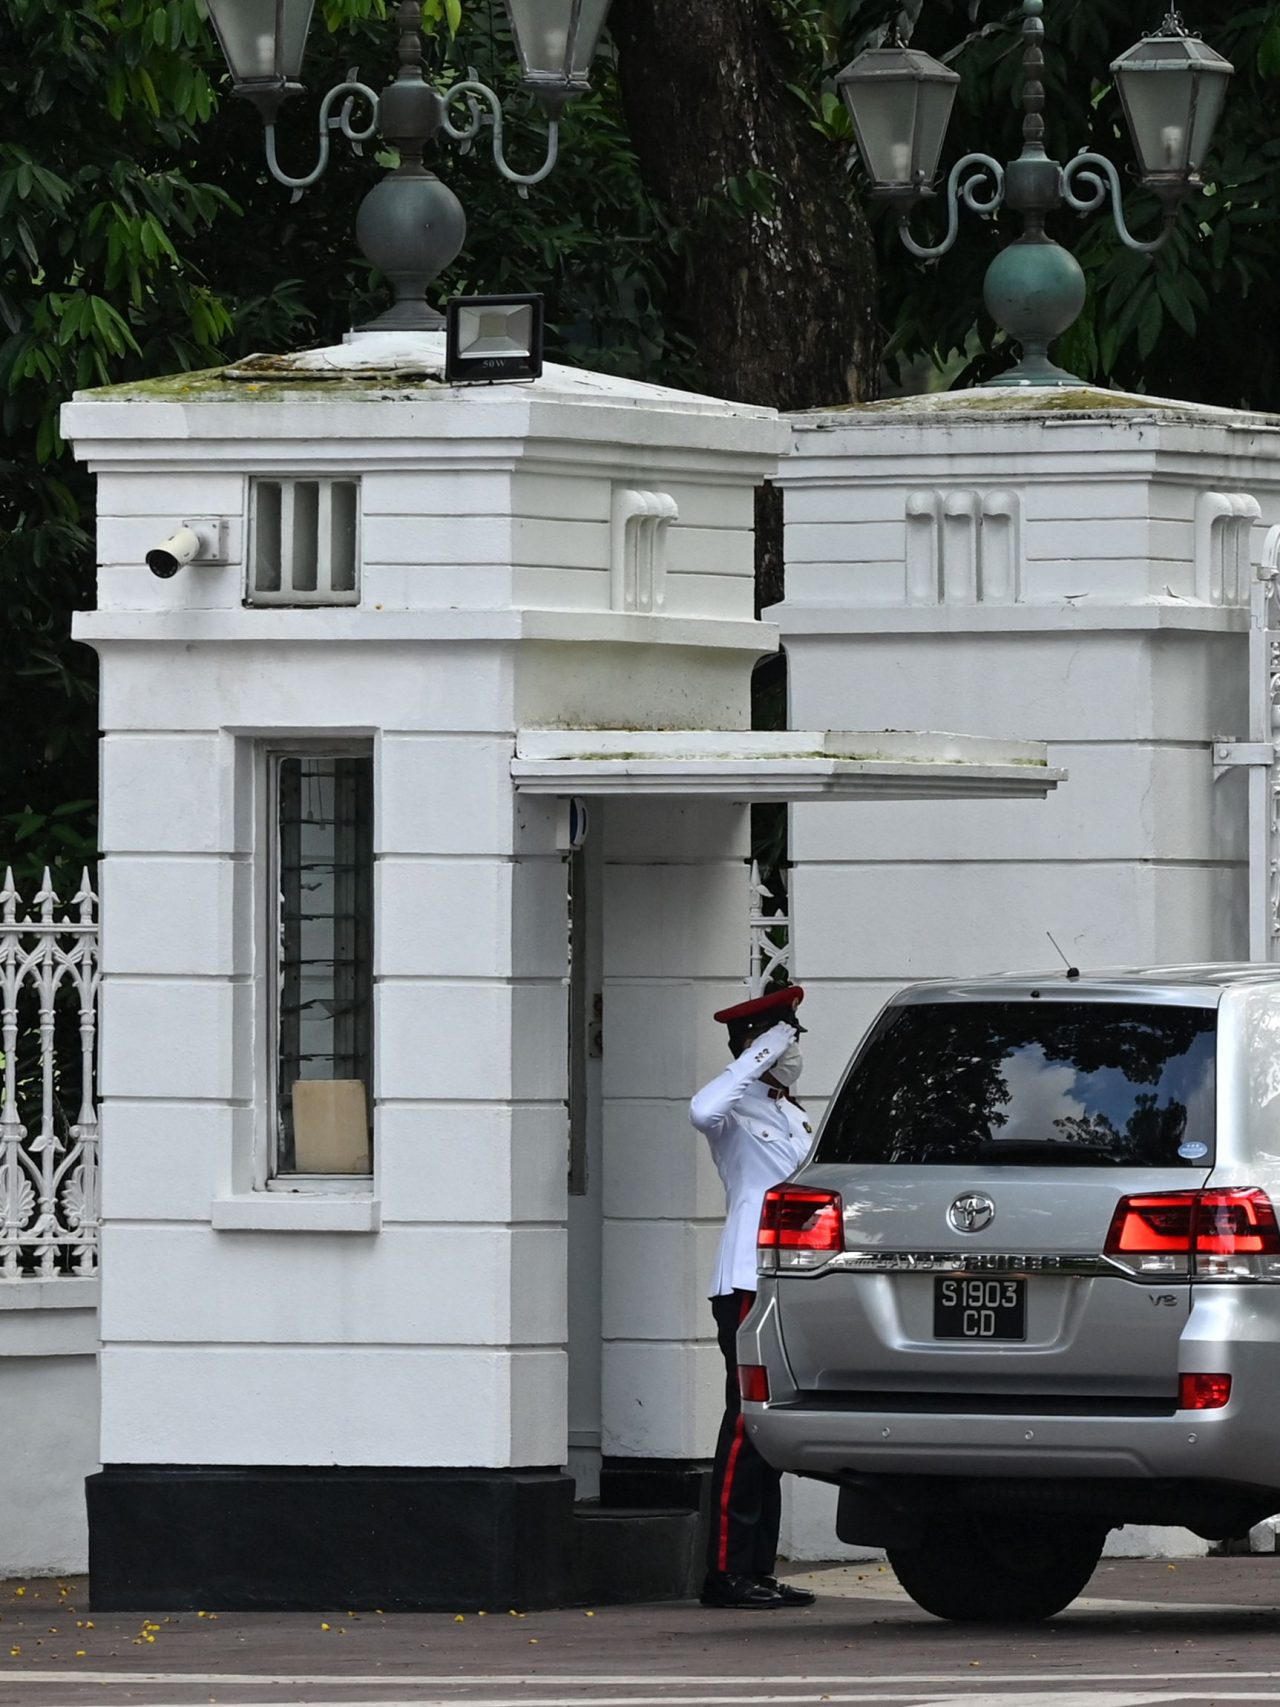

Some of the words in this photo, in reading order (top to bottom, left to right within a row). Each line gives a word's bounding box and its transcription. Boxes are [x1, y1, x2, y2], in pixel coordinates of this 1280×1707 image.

[942, 1280, 1017, 1307] S1903
[1148, 1294, 1177, 1307] V8
[963, 1310, 995, 1336] CD
